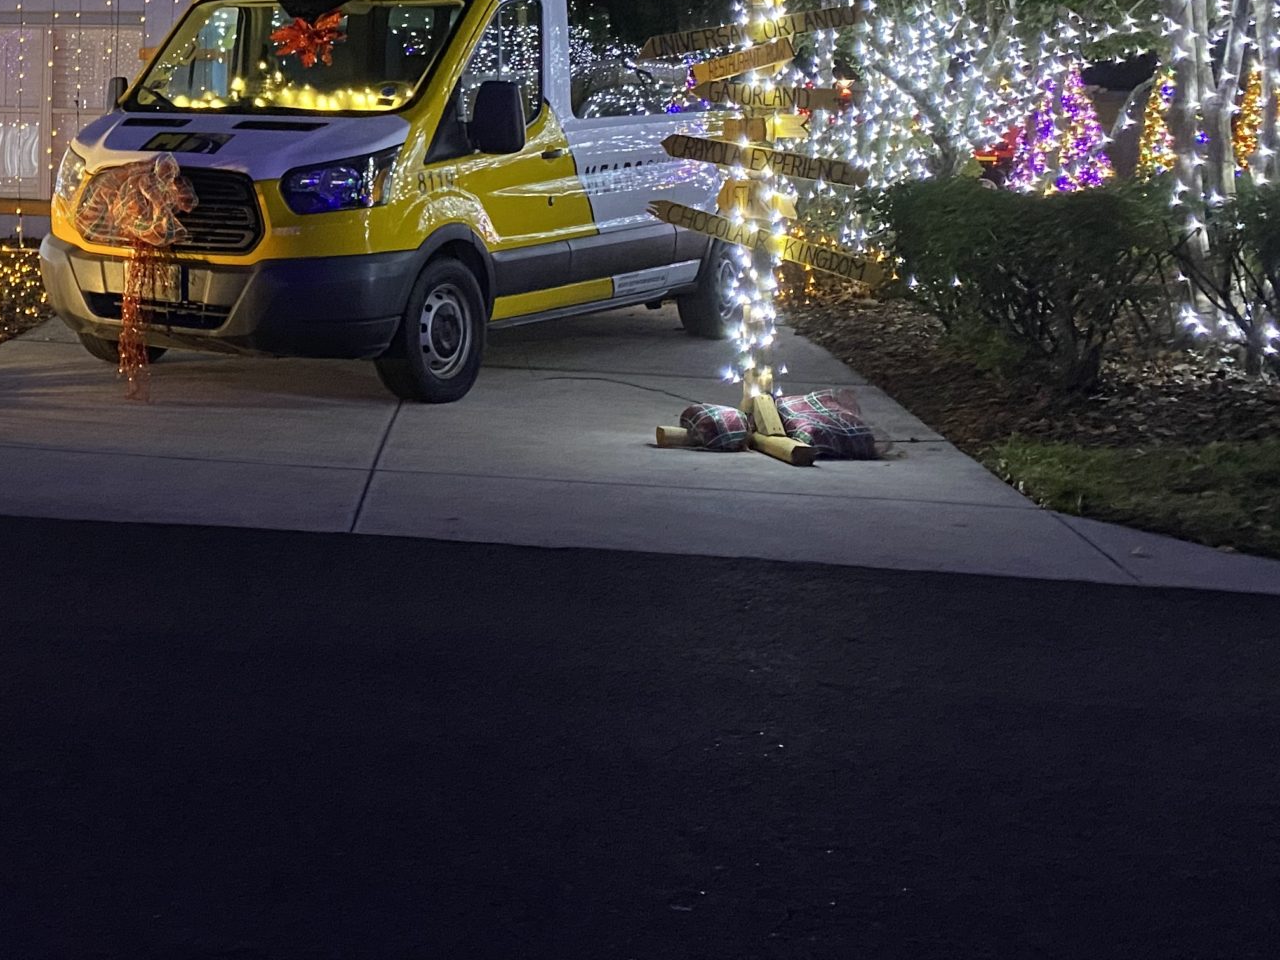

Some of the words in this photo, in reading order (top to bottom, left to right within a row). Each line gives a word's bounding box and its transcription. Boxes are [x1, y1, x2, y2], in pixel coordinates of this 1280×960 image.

[763, 7, 856, 40] ORLANDO
[709, 81, 810, 108] GATORLAND
[671, 136, 741, 164] CRAYOLA
[750, 148, 851, 183] EXPERIENCE
[784, 241, 867, 281] KINGDOM
